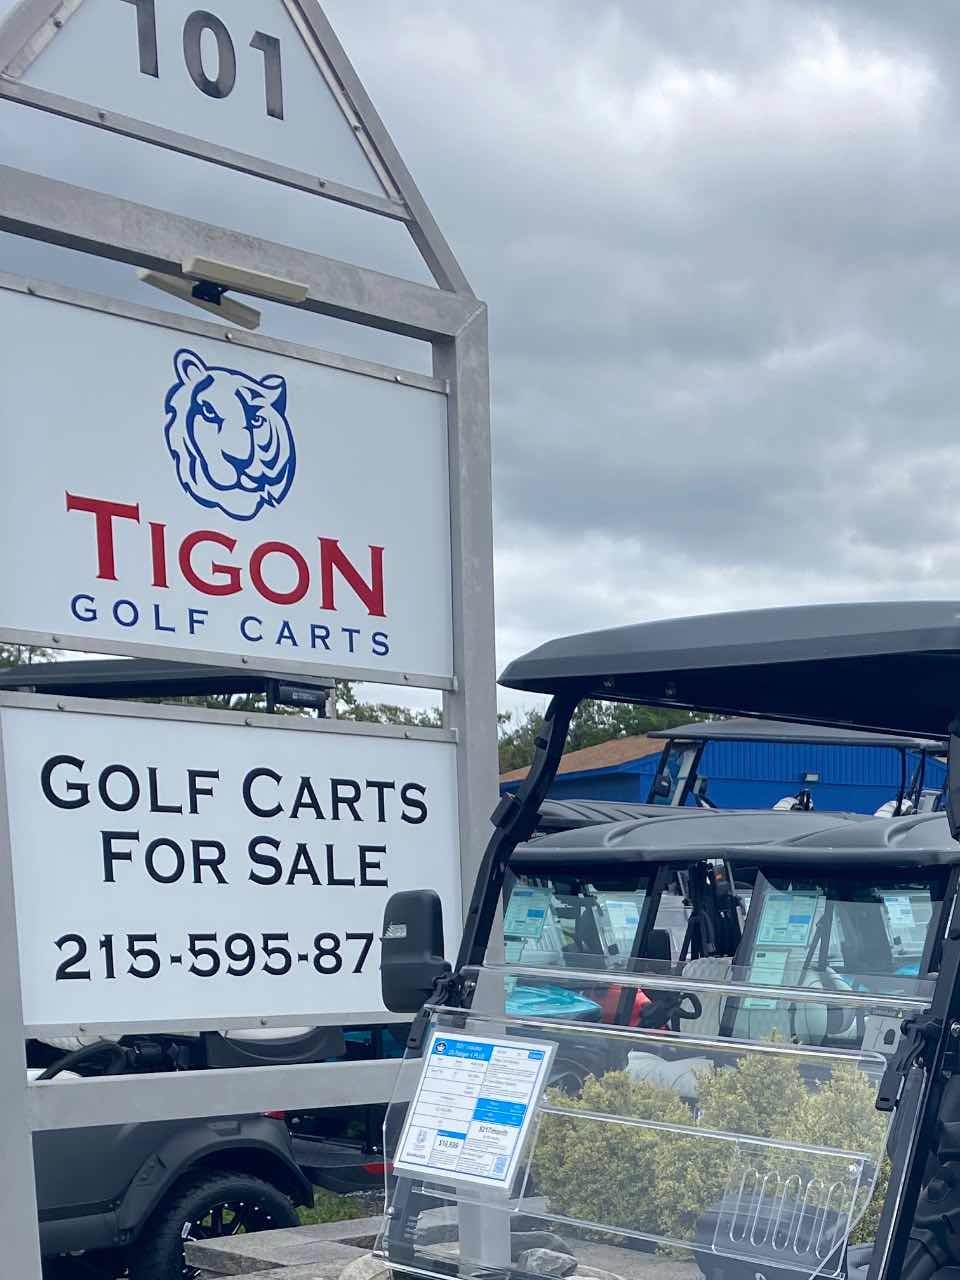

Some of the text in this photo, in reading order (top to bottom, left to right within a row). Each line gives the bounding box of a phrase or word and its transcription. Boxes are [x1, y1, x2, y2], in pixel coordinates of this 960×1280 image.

[121, 0, 284, 120] 101
[66, 490, 386, 618] TIGON
[70, 593, 391, 657] GOLF CARTS
[40, 754, 428, 825] GOLF CARTS
[99, 830, 389, 888] FOR SALE
[54, 932, 382, 982] 215-595-87
